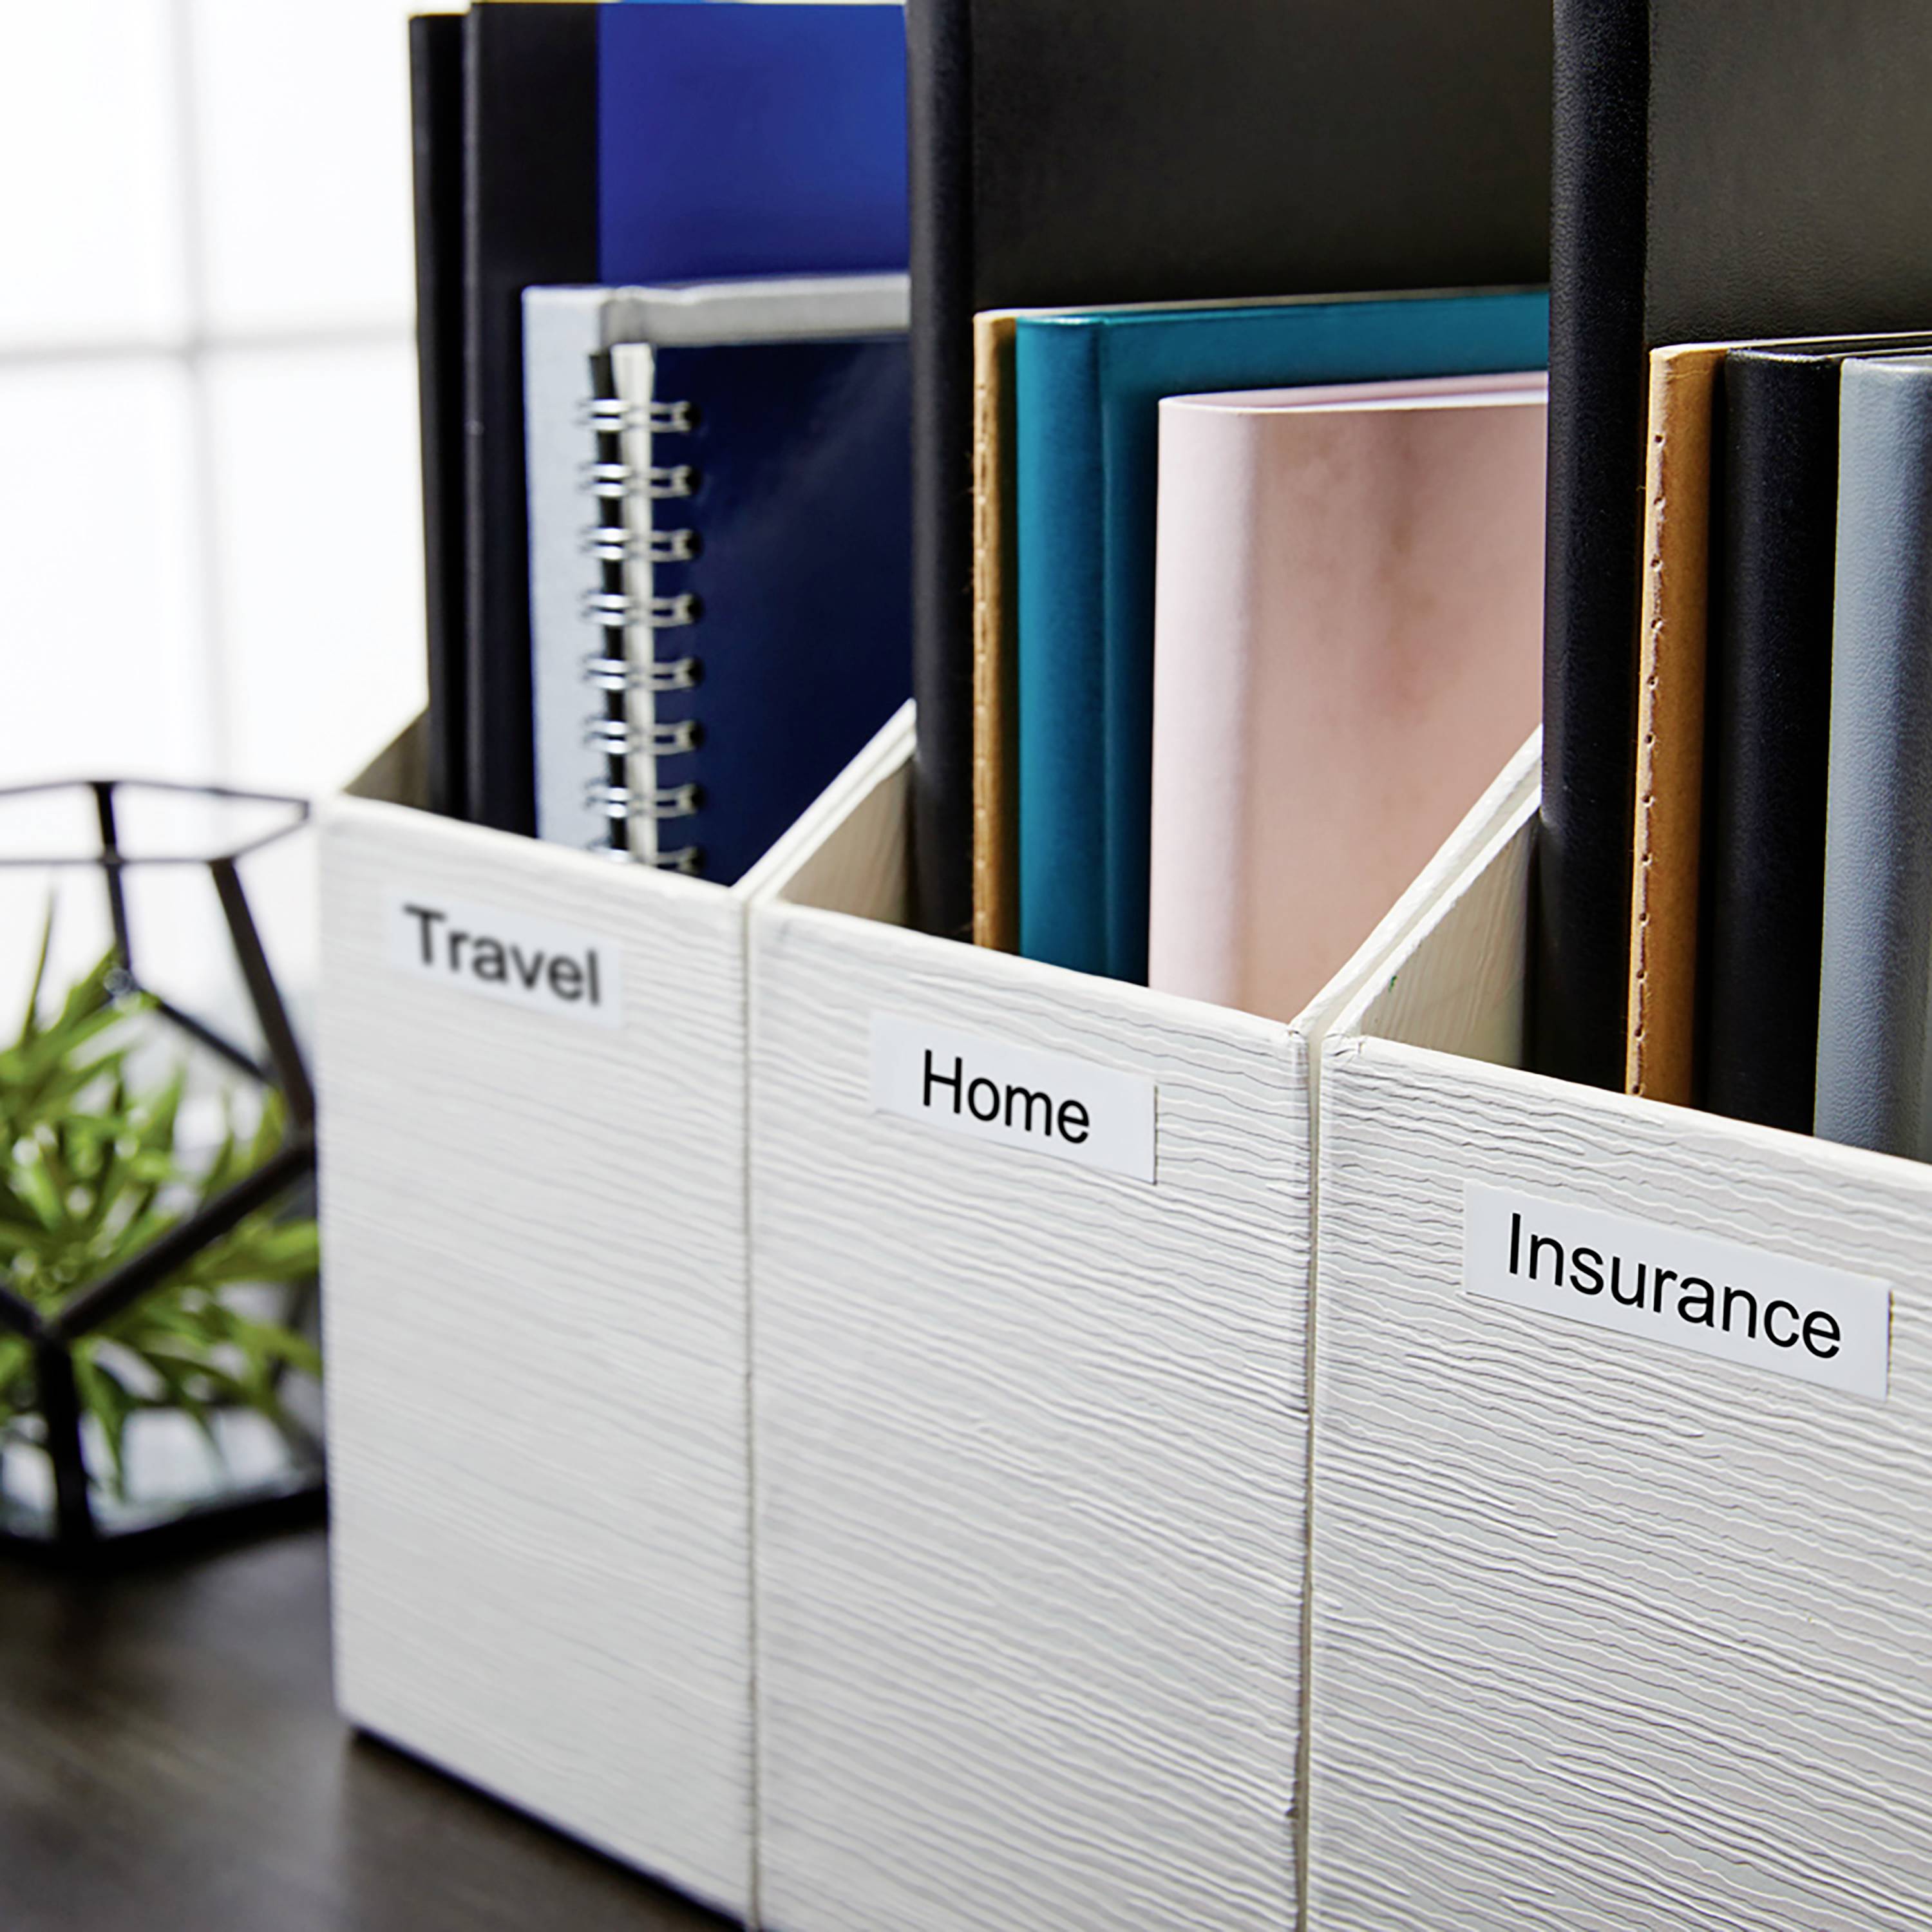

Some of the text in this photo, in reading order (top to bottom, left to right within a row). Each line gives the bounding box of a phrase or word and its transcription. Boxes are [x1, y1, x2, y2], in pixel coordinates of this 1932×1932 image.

[404, 903, 601, 1005] Travel
[922, 1048, 1090, 1144] Home
[1508, 1212, 1841, 1359] Insurance
